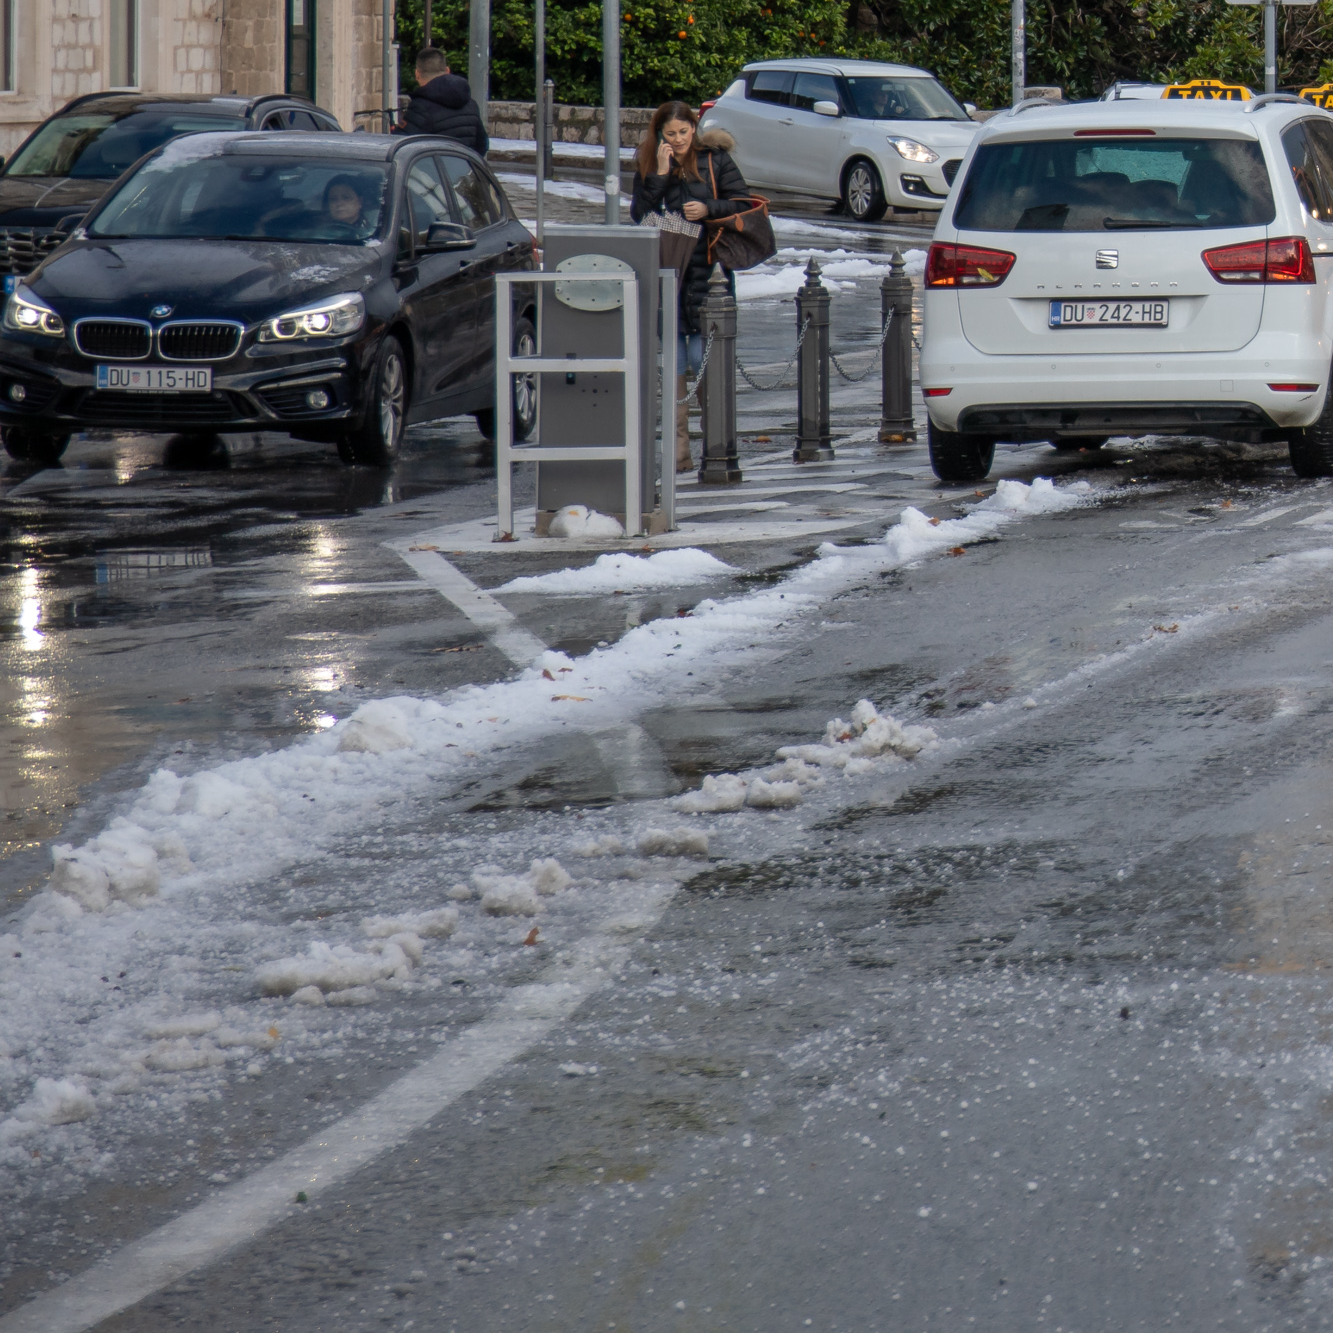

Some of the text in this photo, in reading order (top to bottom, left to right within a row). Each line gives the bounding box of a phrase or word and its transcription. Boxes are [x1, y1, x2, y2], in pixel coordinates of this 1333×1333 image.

[1063, 303, 1164, 322] DU 242-HB
[109, 369, 207, 388] DU 115-HD
